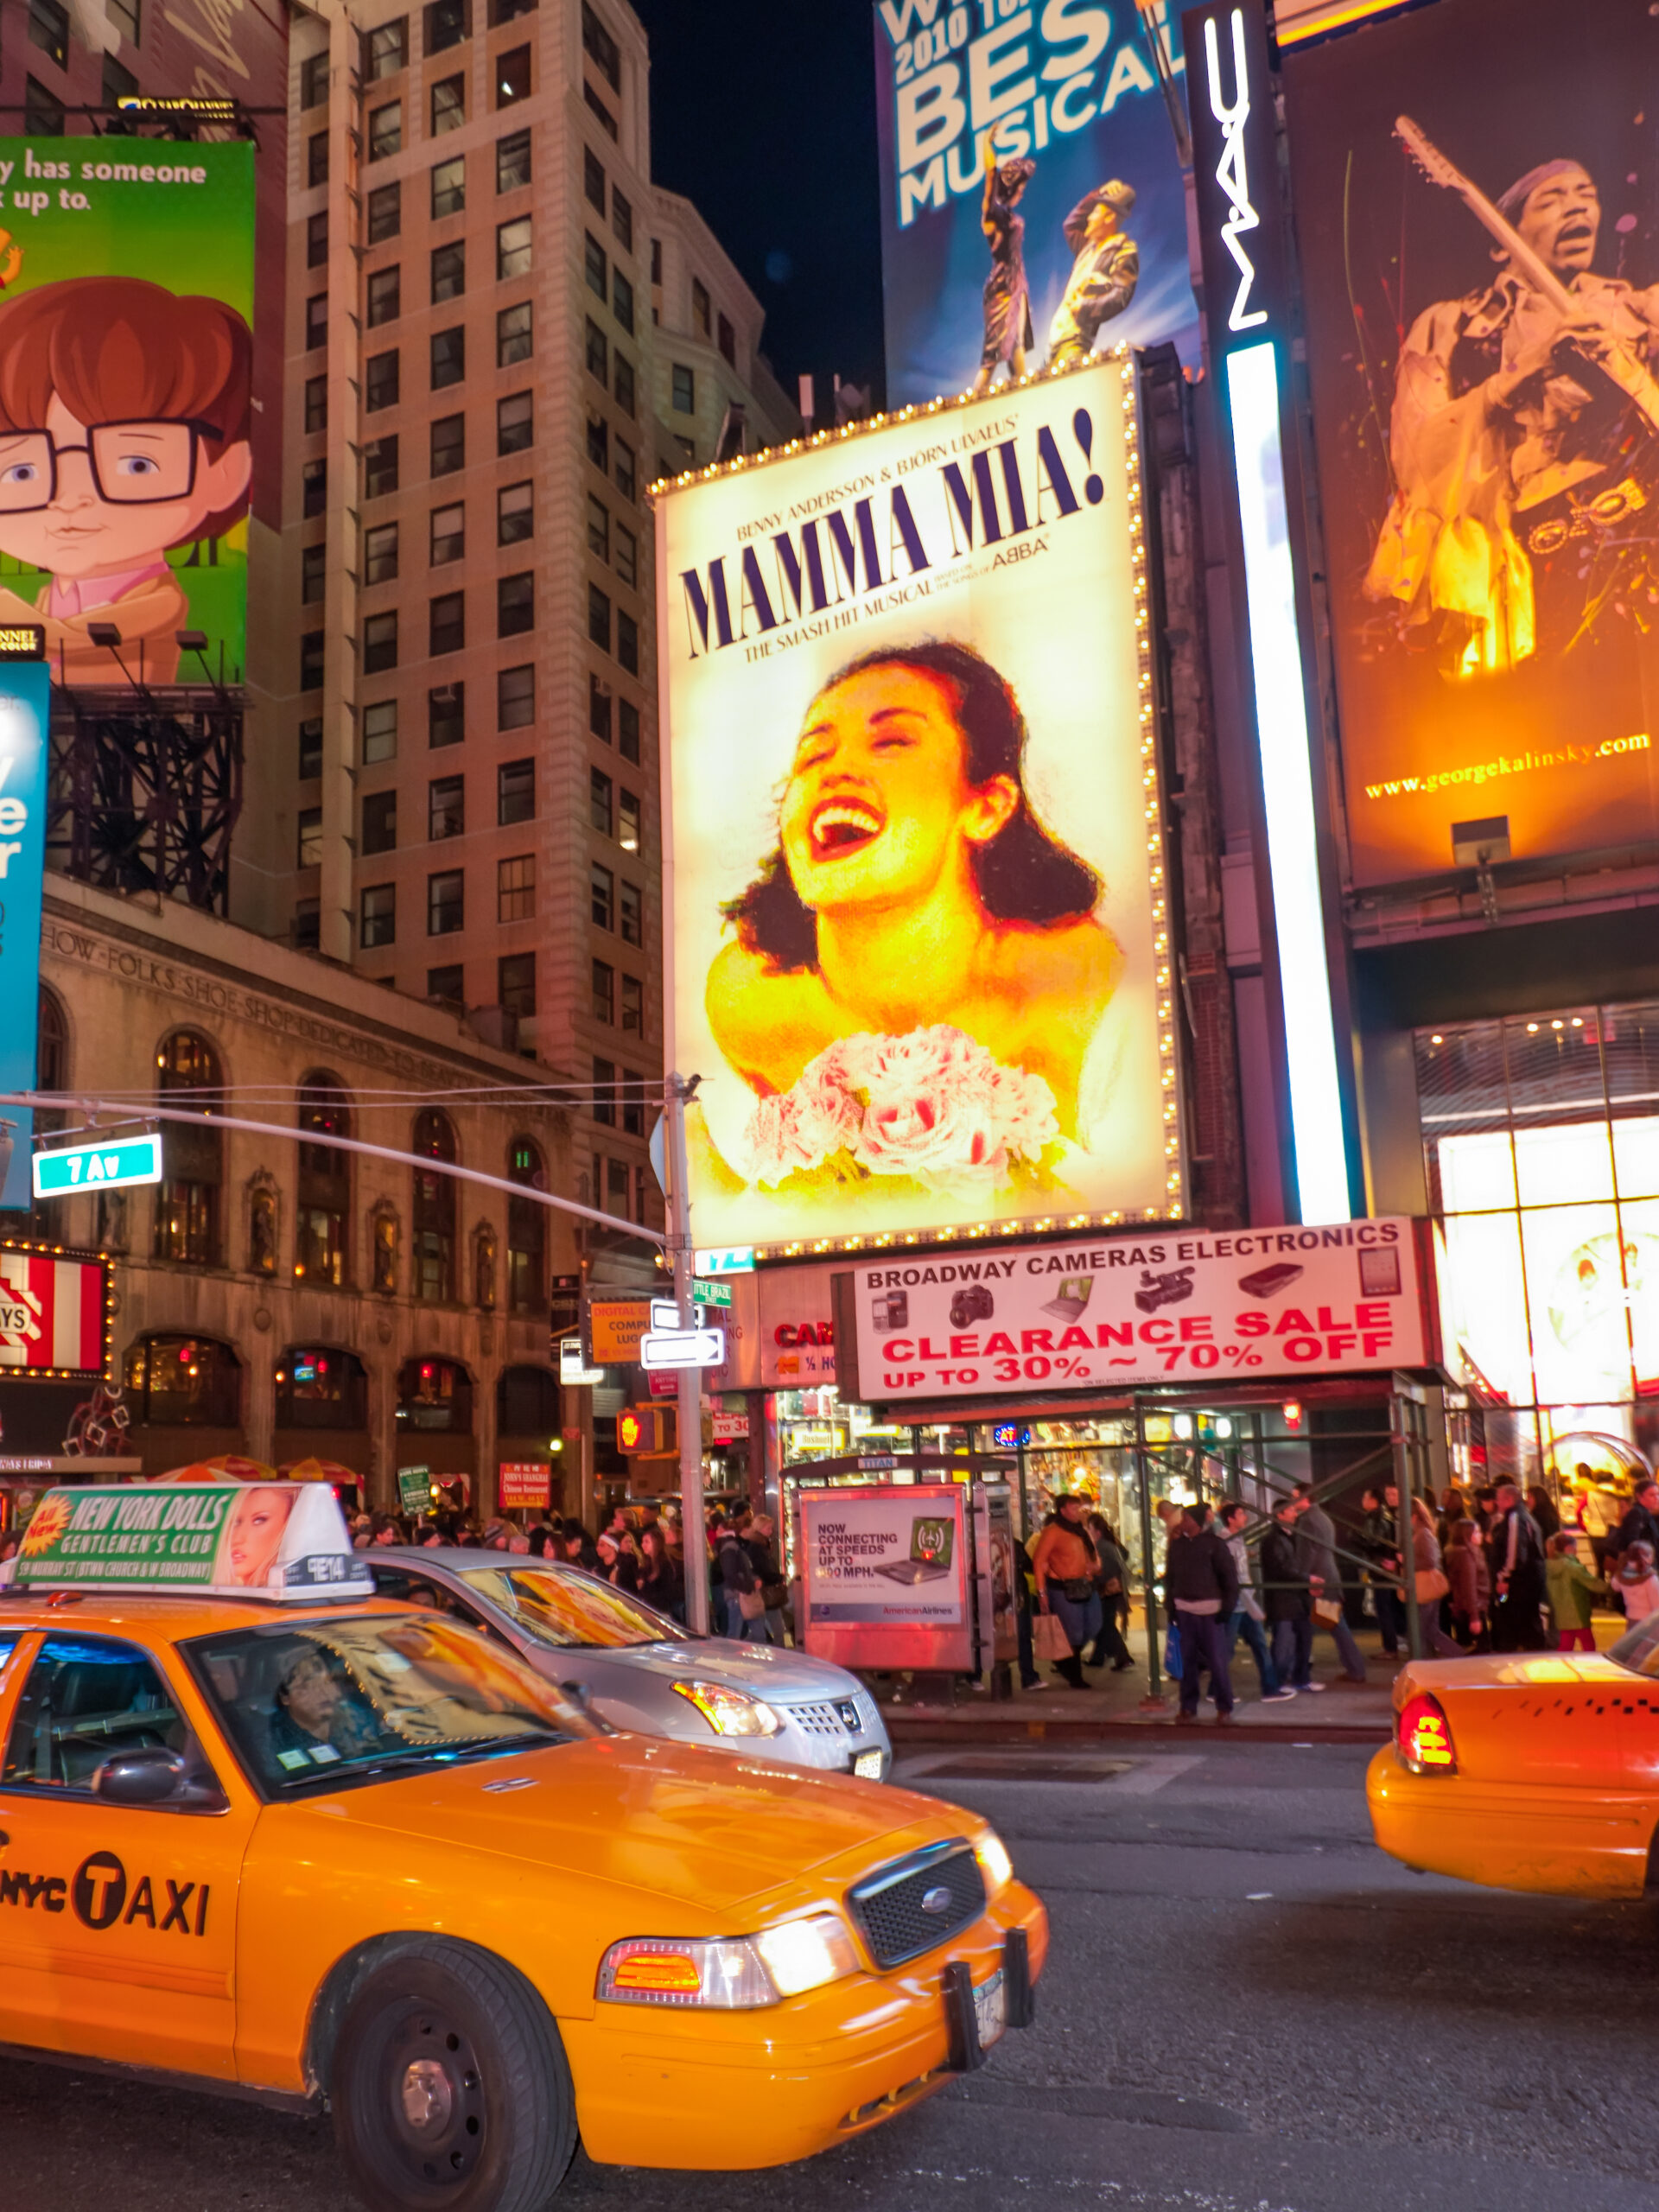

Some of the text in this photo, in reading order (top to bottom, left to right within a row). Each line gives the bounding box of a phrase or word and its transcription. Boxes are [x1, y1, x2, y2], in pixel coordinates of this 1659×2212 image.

[896, 6, 968, 86] 2010
[899, 24, 1186, 227] MUSICAL
[25, 148, 71, 180] has
[81, 162, 207, 184] someone
[14, 191, 49, 216] up
[59, 188, 92, 209] to.
[737, 512, 783, 543] BENNY
[787, 474, 875, 524] ANDERSSON
[880, 466, 892, 483] &
[897, 444, 948, 476] BJÖRN
[678, 408, 1104, 660] MAMMA MIA!
[745, 580, 934, 664] THE SMASH HIT MUSICAL
[1365, 733, 1651, 799] www.georgekalinsky.com
[107, 948, 175, 991] FOLKS
[184, 975, 238, 1013] SHOE
[245, 996, 293, 1031] SHOP
[67, 1155, 82, 1184] 7
[867, 1223, 1400, 1290] BROADWAY CAMERAS ELECTRONICS
[711, 1285, 731, 1300] BRAZIL
[594, 1306, 635, 1317] DIGITAL
[617, 1334, 641, 1344] LUG
[882, 1301, 1393, 1363] CLEARANCE SALE
[883, 1372, 926, 1389] UP
[935, 1369, 980, 1386] TO
[994, 1356, 1091, 1383] 30%
[1156, 1344, 1263, 1372] 70%
[1282, 1332, 1394, 1363] OFF
[718, 1423, 731, 1433] TO
[861, 1458, 893, 1468] TITAN
[523, 1472, 549, 1482] SHANGHAI
[503, 1484, 522, 1494] Chinese
[37, 1506, 58, 1523] All
[68, 1493, 230, 1531] NEW YORK DOLLS
[29, 1522, 57, 1538] New
[818, 1523, 846, 1535] NOW
[818, 1534, 898, 1545] CONNECTING
[60, 1534, 214, 1554] GENTLEMEN'S CLUB
[819, 1545, 885, 1555] AT SPEEDS
[17, 1561, 212, 1580] 59 MURRAY ST (BTWN CHURCH & W BROADWAY)
[307, 1556, 346, 1582] 9E14
[819, 1556, 854, 1567] UP TO
[843, 1567, 874, 1578] MPH.
[0, 1850, 210, 1937] NYC TAXI
